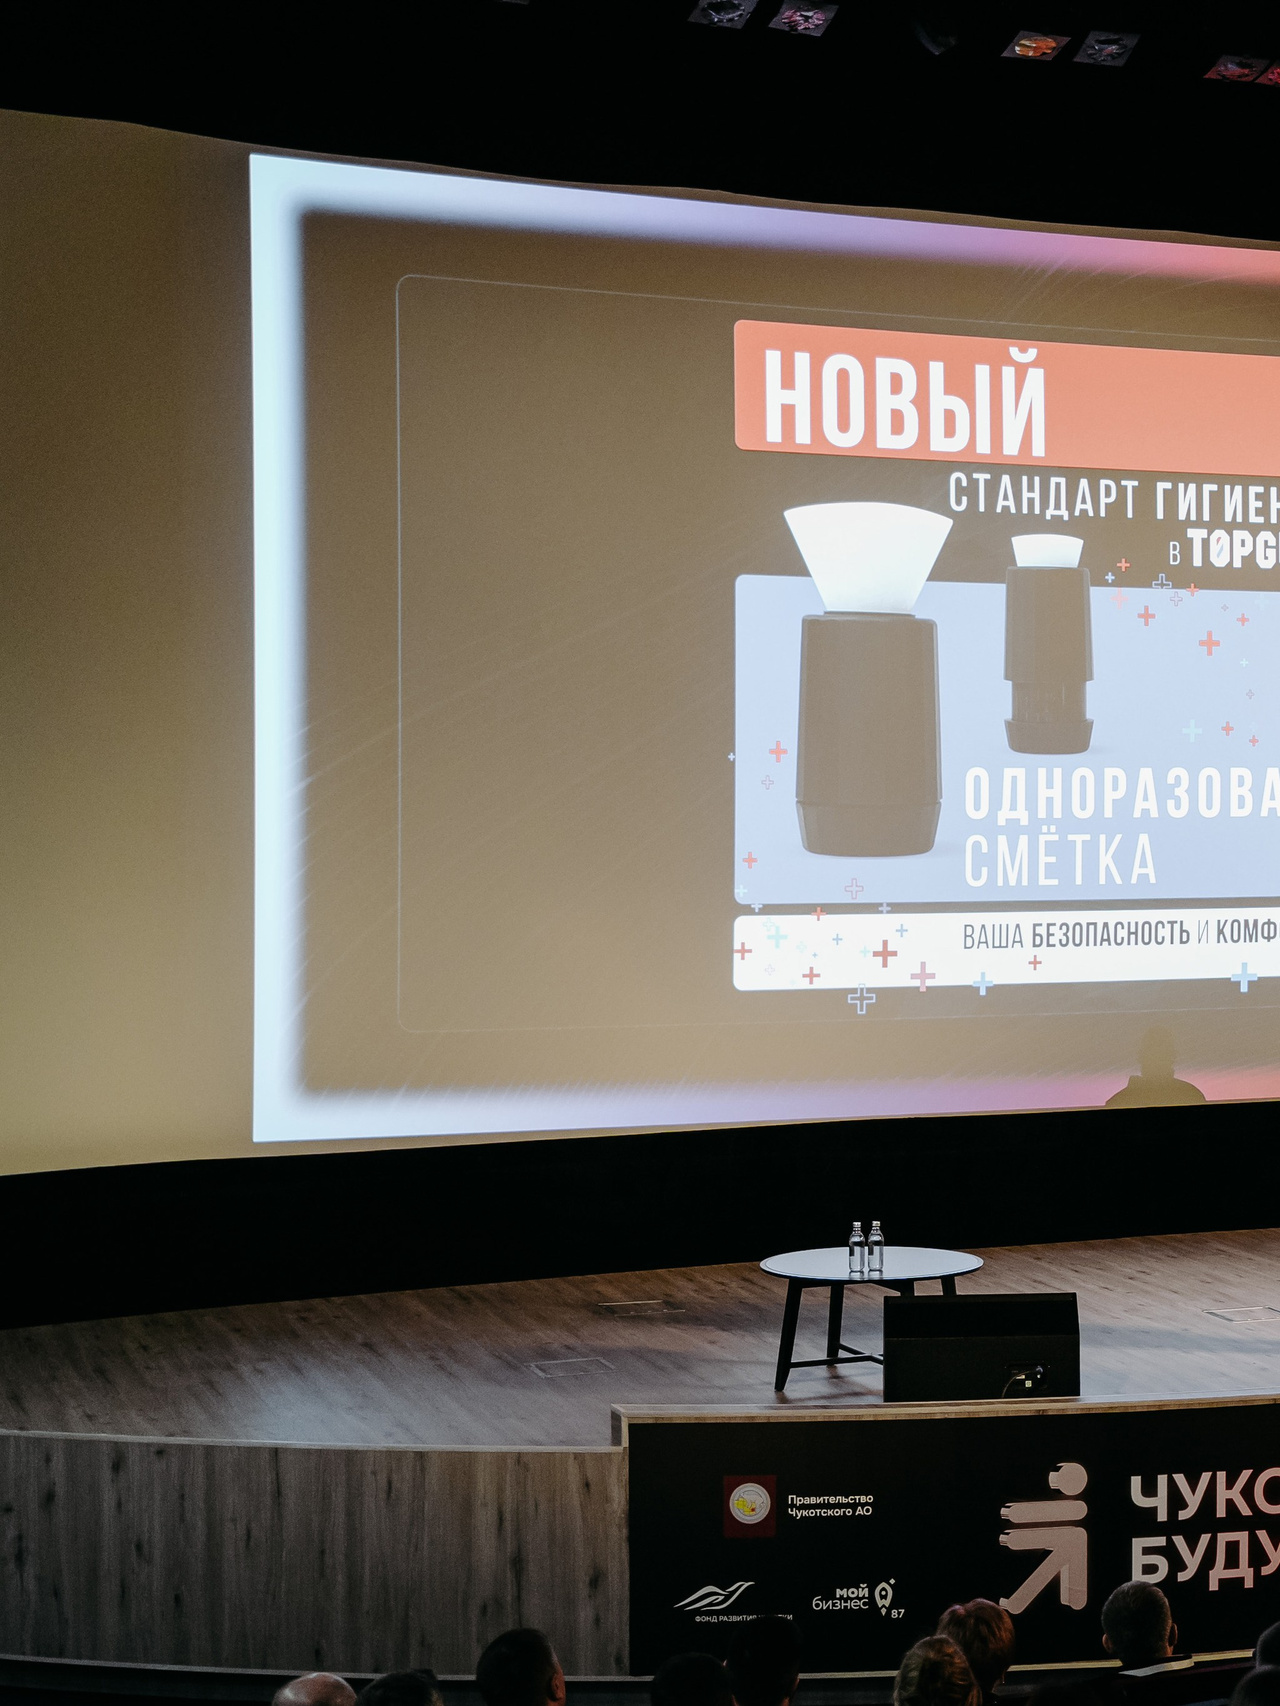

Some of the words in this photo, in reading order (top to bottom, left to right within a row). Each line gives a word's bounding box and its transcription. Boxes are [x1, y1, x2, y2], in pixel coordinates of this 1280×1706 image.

[765, 346, 1046, 457] НОВЫЙ
[949, 471, 1139, 521] СТАНДАРТ
[964, 825, 1157, 888] СМЁТКА
[963, 923, 1025, 950] ВАША
[1031, 919, 1191, 949] БЕЗОПАСНОСТЬ
[1197, 919, 1209, 944] И
[788, 1494, 874, 1506] Правительство
[788, 1507, 852, 1519] Чукотского
[855, 1505, 873, 1516] АО
[812, 1596, 869, 1610] бизнес
[695, 1615, 718, 1623] ФОНД
[891, 1609, 905, 1619] 87
